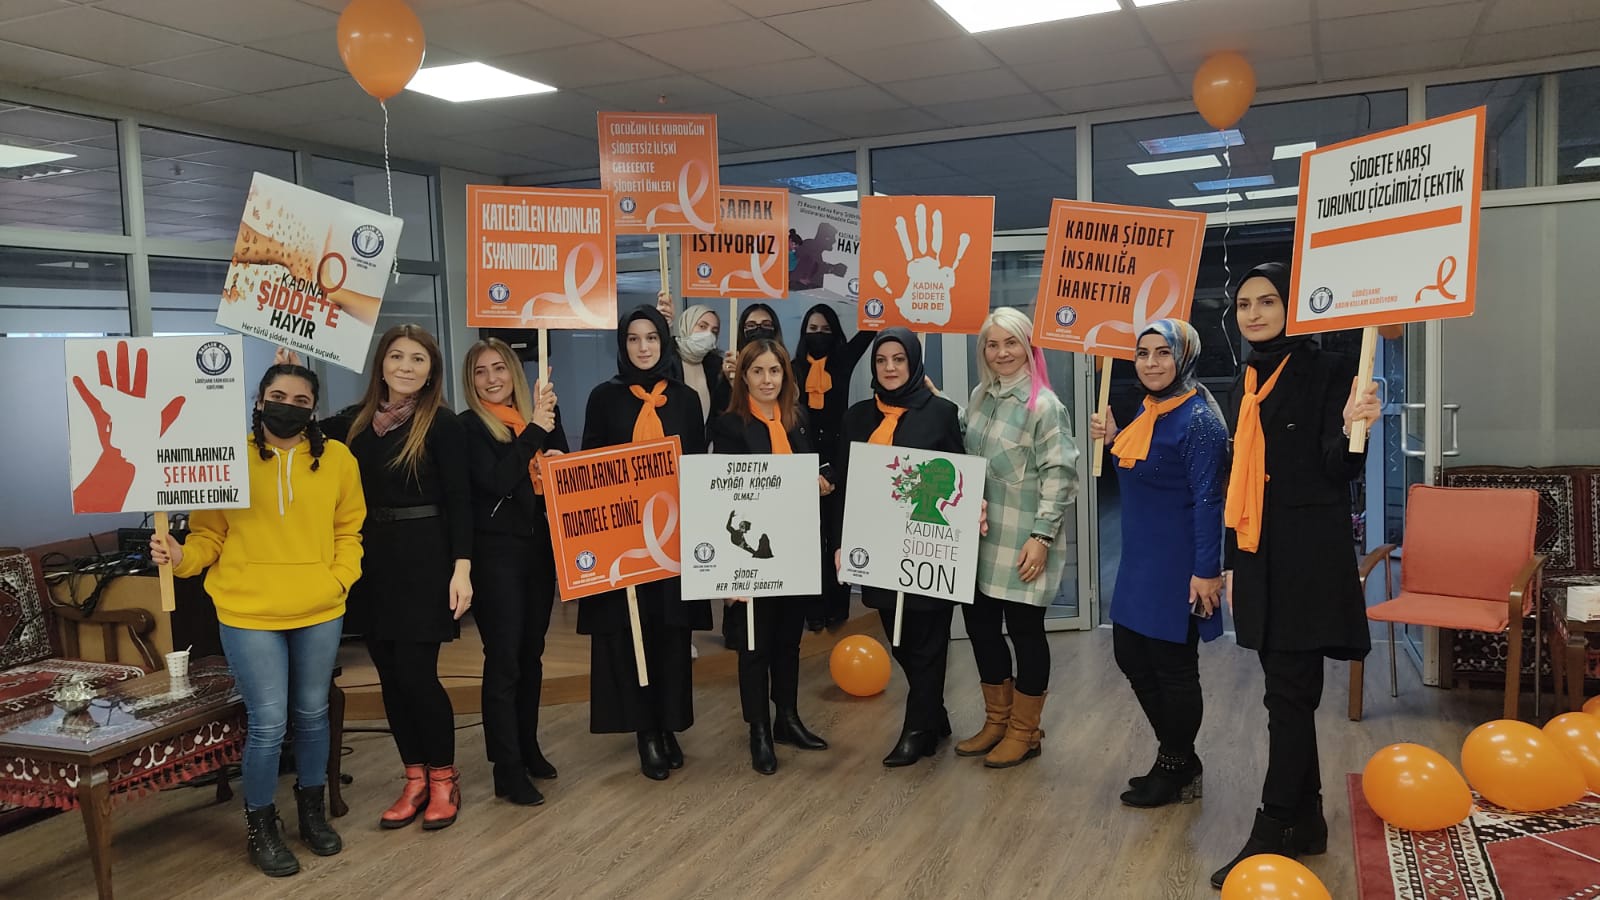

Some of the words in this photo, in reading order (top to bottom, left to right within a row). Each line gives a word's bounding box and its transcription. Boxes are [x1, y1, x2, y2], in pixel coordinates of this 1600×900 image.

[610, 121, 647, 136] ÇOCUĞUN
[648, 122, 660, 135] İLE
[661, 121, 704, 136] KURDUĞUN
[654, 140, 677, 156] İLİŞKİ
[612, 162, 655, 173] GELECEKTE
[1349, 153, 1394, 186] ŞİDDETE
[1395, 144, 1431, 172] KARŞI
[1317, 190, 1365, 219] TURUNCU
[1368, 173, 1421, 213] ÇİZGİMİZİ
[1423, 166, 1465, 202] ÇEKTİK
[482, 200, 545, 232] KATLEDİLEN
[547, 206, 601, 234] KADINLAR
[837, 238, 860, 255] HAY
[1065, 220, 1119, 243] KADINA
[1122, 222, 1175, 248] ŞİDDET
[482, 236, 558, 271] İSYANIMIZDIR
[1061, 245, 1136, 275] İNSANLIĞA
[280, 272, 324, 300] KADINA
[913, 281, 944, 290] KADINA
[1057, 275, 1131, 304] İHANETTİR
[912, 302, 928, 310] DUR
[241, 322, 254, 330] Her
[254, 326, 268, 337] türlü
[290, 338, 314, 352] insanlık
[269, 309, 316, 340] HAYIR
[157, 447, 235, 463] HANIMLARINIZA
[164, 464, 230, 486] ŞEFKATLE
[555, 458, 630, 495] HANIMLARINIZA
[631, 450, 674, 486] ŞEFKATLE
[157, 489, 205, 505] MUAMELE
[208, 485, 239, 503] EDİNİZ
[562, 505, 608, 539] MUAMELE
[610, 495, 641, 529] EDİNİZ
[905, 521, 954, 542] KADINA
[902, 537, 960, 562] ŞİDDETE
[716, 582, 728, 591] HER
[733, 568, 759, 580] ŞİDDET
[898, 558, 956, 595] SON
